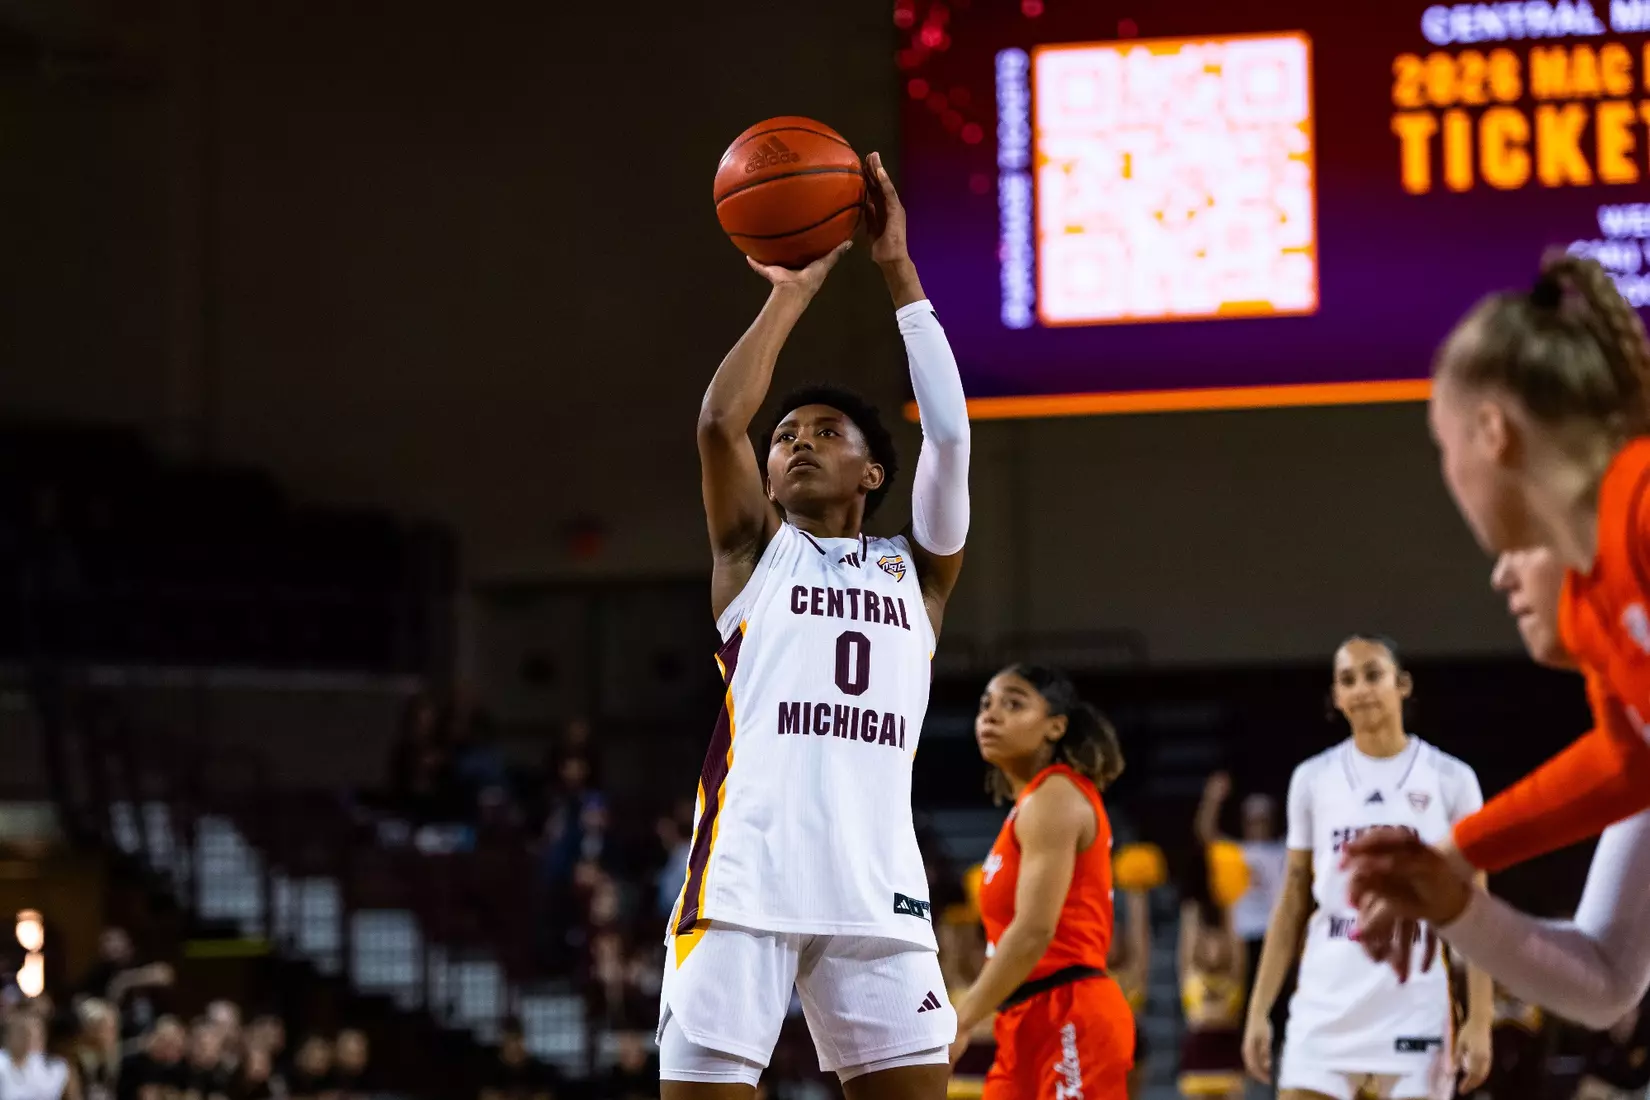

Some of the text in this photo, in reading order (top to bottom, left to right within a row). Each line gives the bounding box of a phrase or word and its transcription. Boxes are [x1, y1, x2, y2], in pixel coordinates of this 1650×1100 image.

[744, 151, 800, 174] adidas
[1390, 99, 1650, 195] TICKE
[790, 584, 912, 631] CENTRAL
[834, 630, 871, 697] 0
